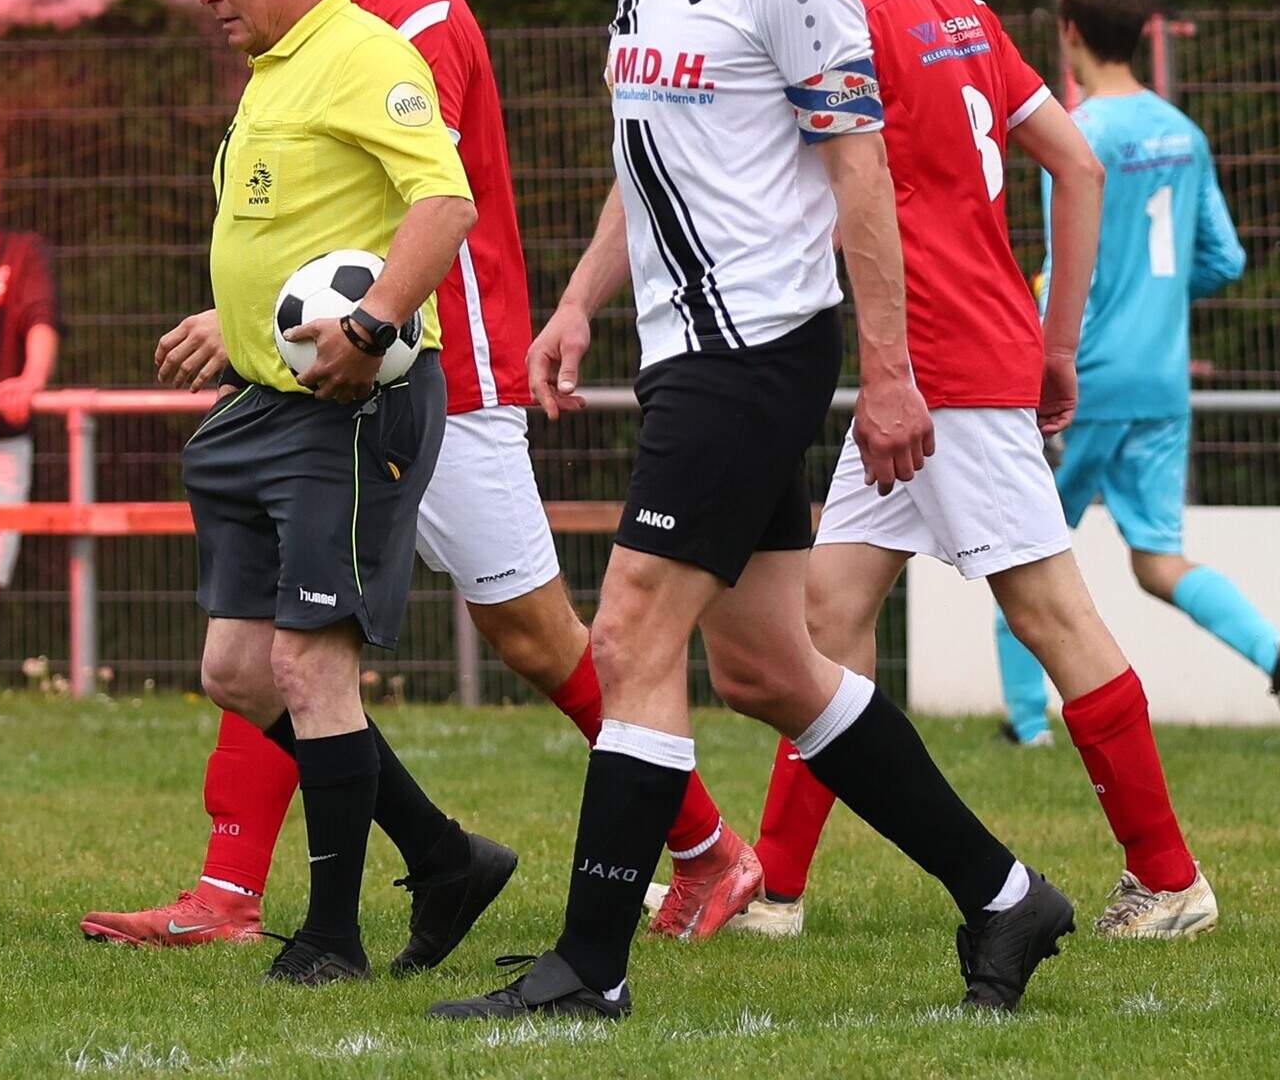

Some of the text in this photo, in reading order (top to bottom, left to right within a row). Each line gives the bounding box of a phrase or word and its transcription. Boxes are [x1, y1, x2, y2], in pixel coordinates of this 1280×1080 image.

[614, 46, 715, 90] M.D.H.
[394, 94, 427, 117] ARAG
[652, 90, 664, 102] De
[666, 90, 696, 104] Horne
[699, 94, 715, 105] BV
[248, 196, 270, 205] KNVB
[1145, 184, 1176, 278] 1
[636, 508, 676, 530] JAKO
[578, 858, 639, 882] JAKO
